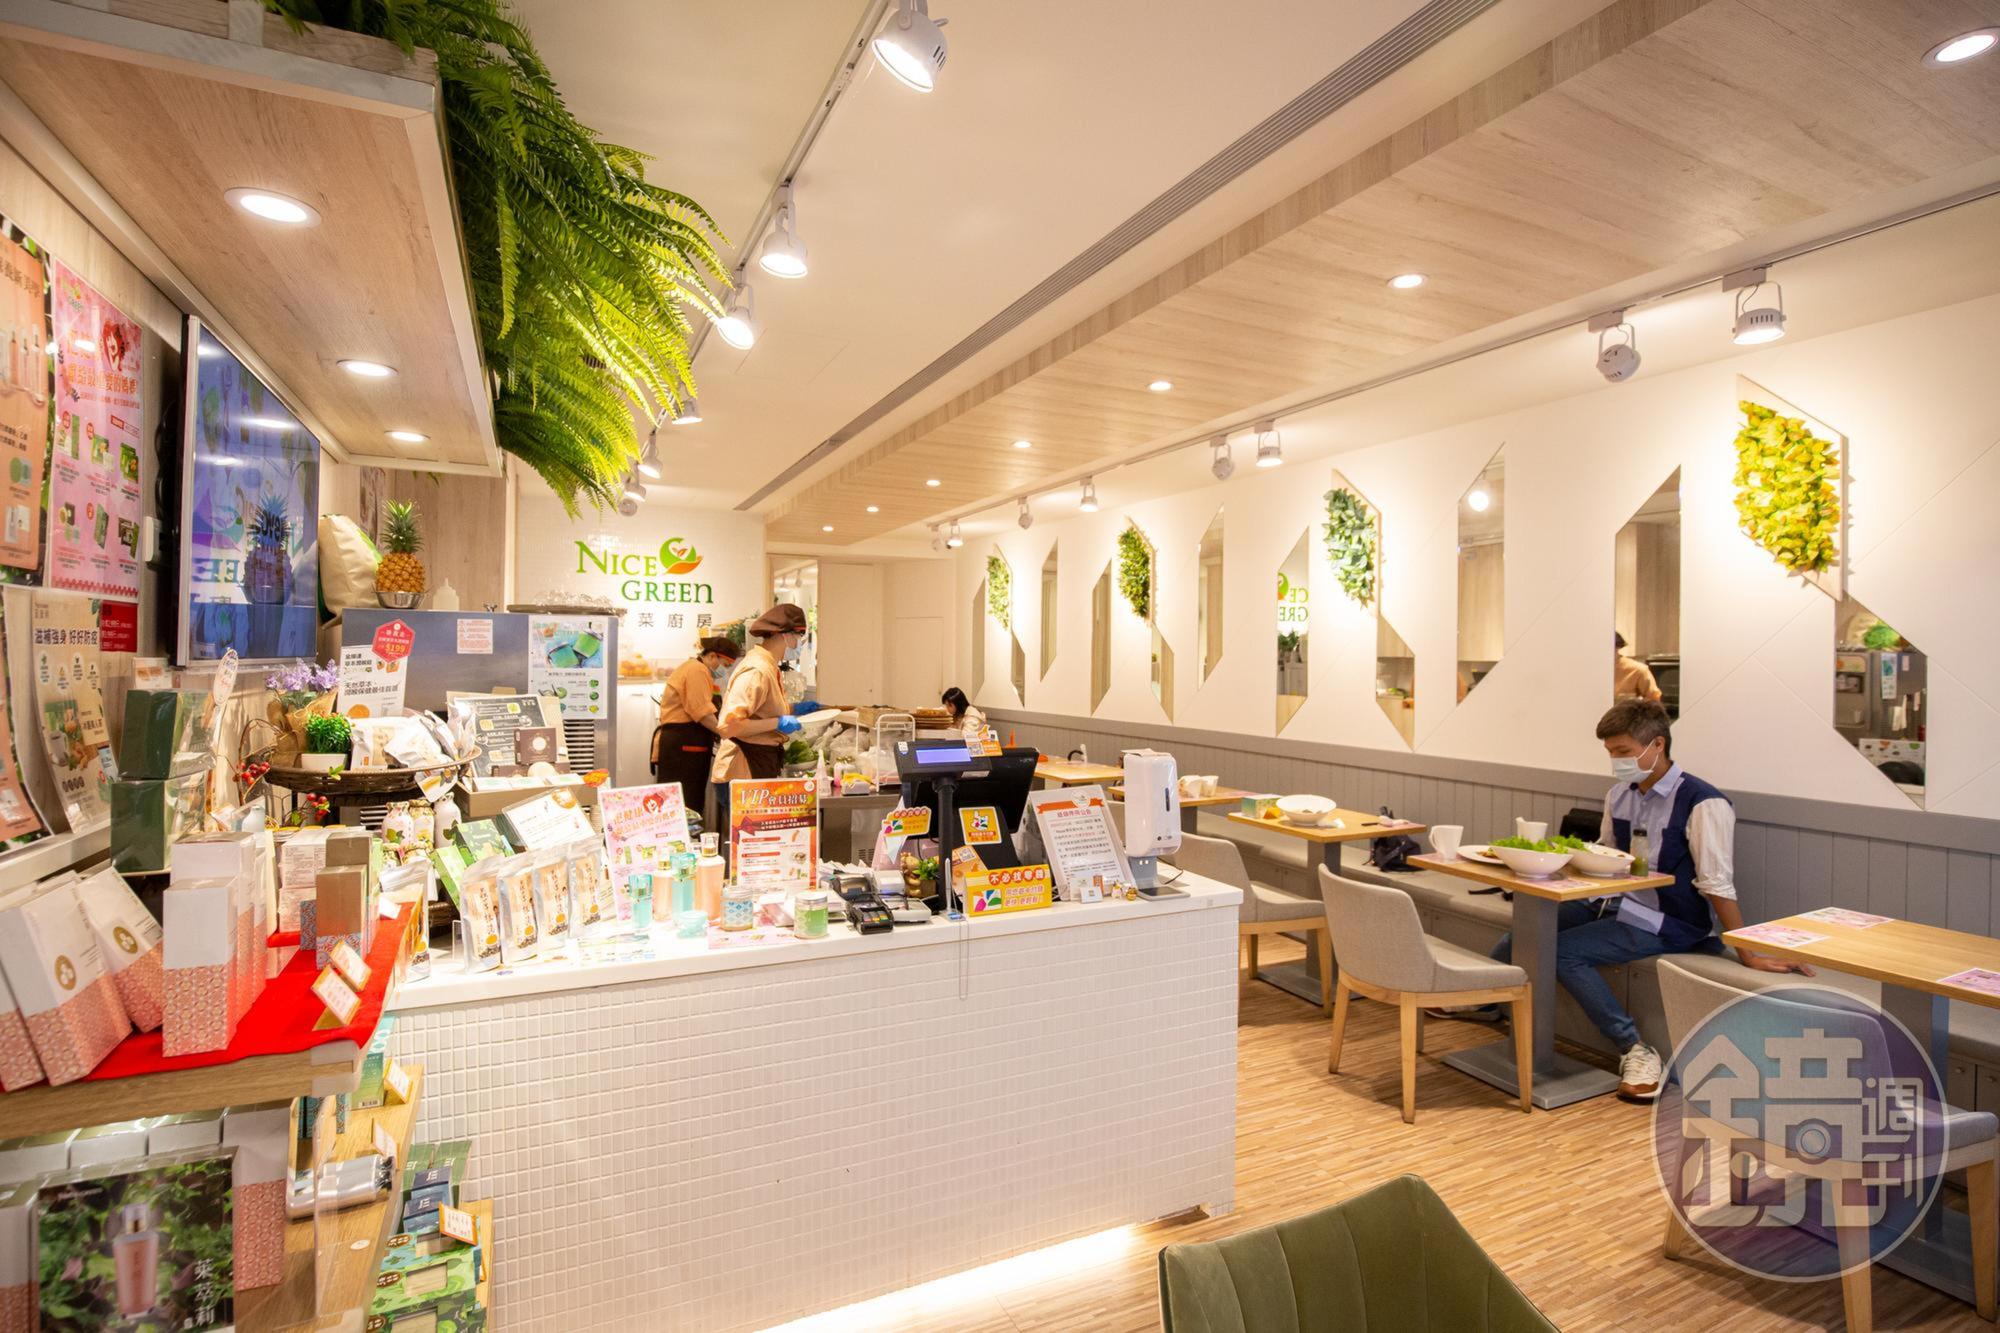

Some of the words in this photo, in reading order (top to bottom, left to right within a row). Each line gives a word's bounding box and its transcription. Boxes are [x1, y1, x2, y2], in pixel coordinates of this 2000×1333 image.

[574, 540, 657, 576] NICE
[69, 629, 98, 645] 好好防疫
